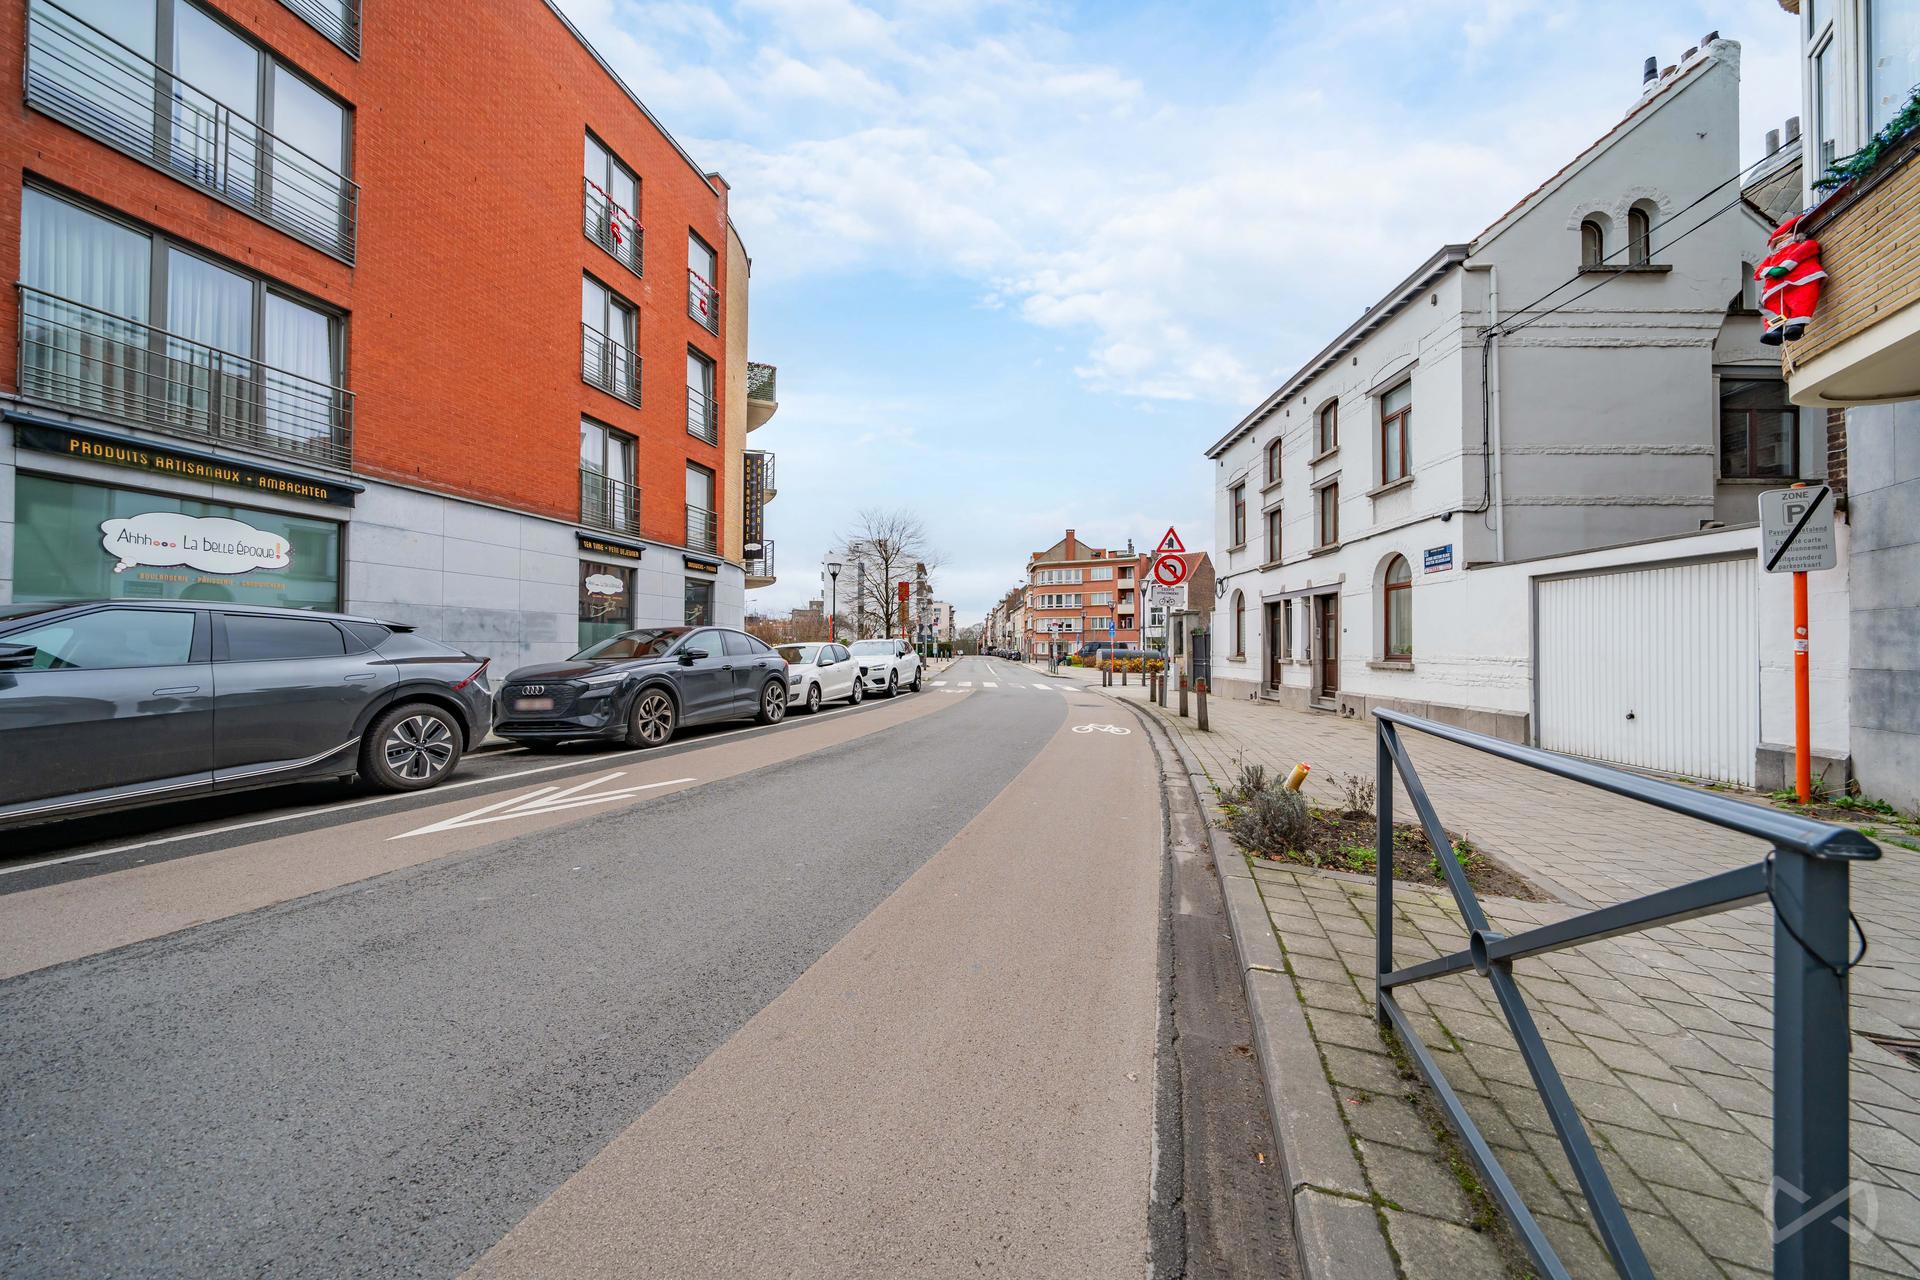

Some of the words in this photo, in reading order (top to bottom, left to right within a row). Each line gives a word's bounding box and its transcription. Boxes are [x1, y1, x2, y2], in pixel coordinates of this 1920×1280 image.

[69, 440, 148, 465] PRODUITS
[155, 456, 240, 482] ARTISANAUX
[259, 477, 327, 499] AMBACHTEN
[1781, 491, 1809, 500] ZONE
[183, 535, 198, 550] La
[1779, 553, 1822, 562] itgezonderd
[1778, 561, 1821, 570] parkeerkaart
